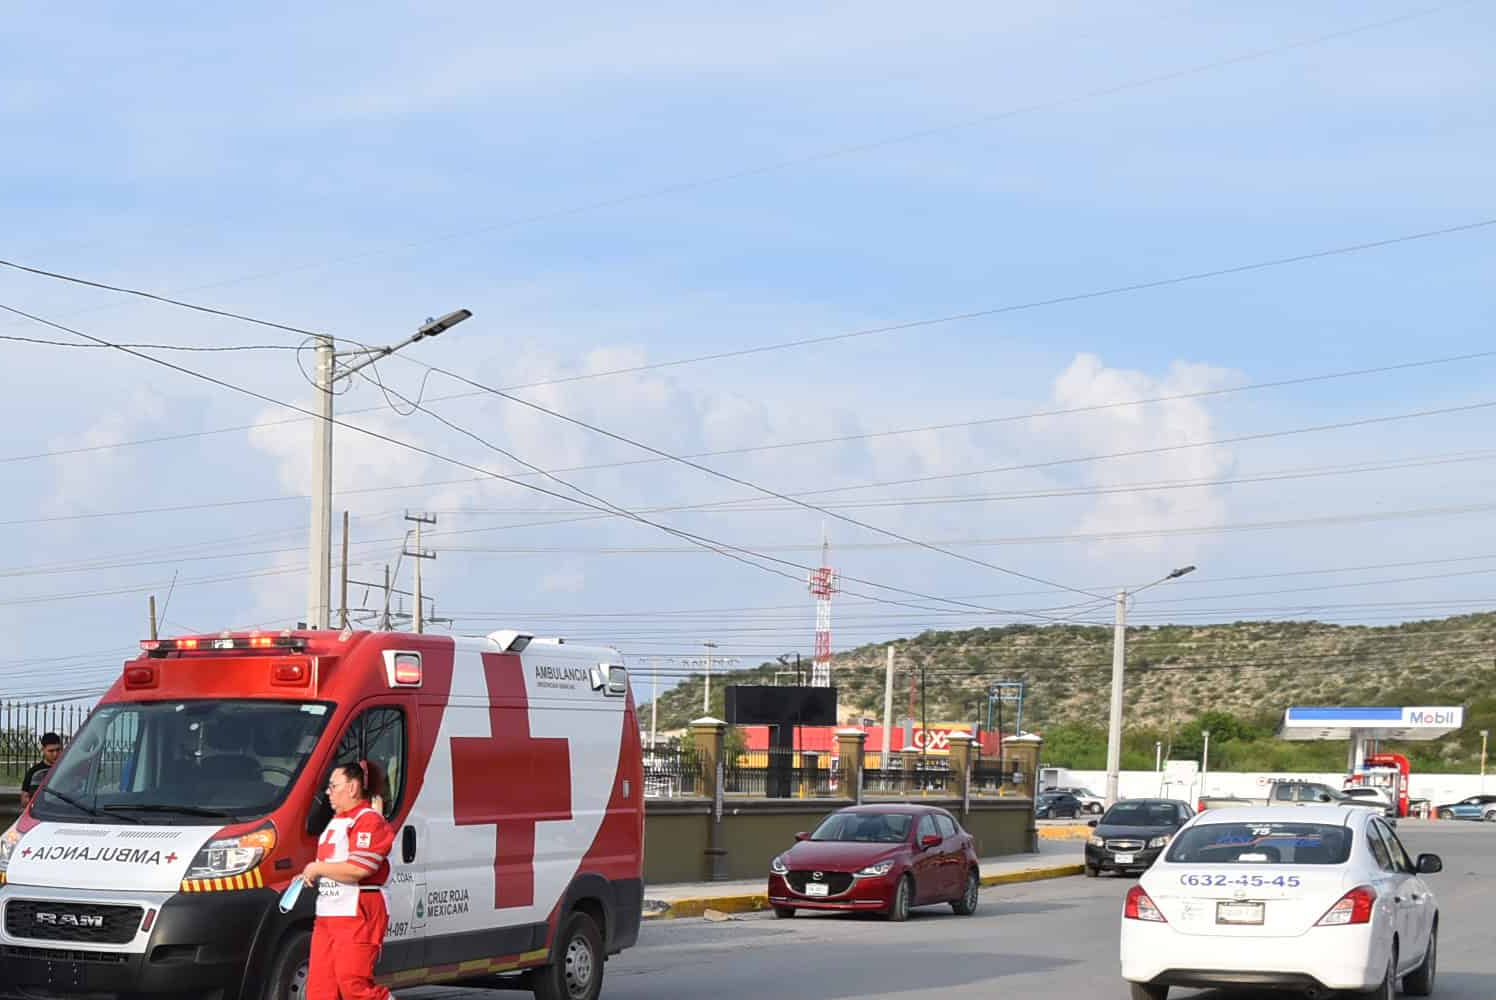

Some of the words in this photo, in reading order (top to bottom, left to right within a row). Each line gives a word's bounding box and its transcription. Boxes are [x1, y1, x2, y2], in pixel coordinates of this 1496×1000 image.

[535, 665, 588, 681] AMBULANCIA
[1409, 711, 1454, 725] Mobil
[914, 730, 951, 749] OX
[427, 891, 448, 904] CRUZ
[449, 888, 469, 902] ROJA
[427, 902, 469, 917] MEXICANA
[36, 912, 104, 928] RAM
